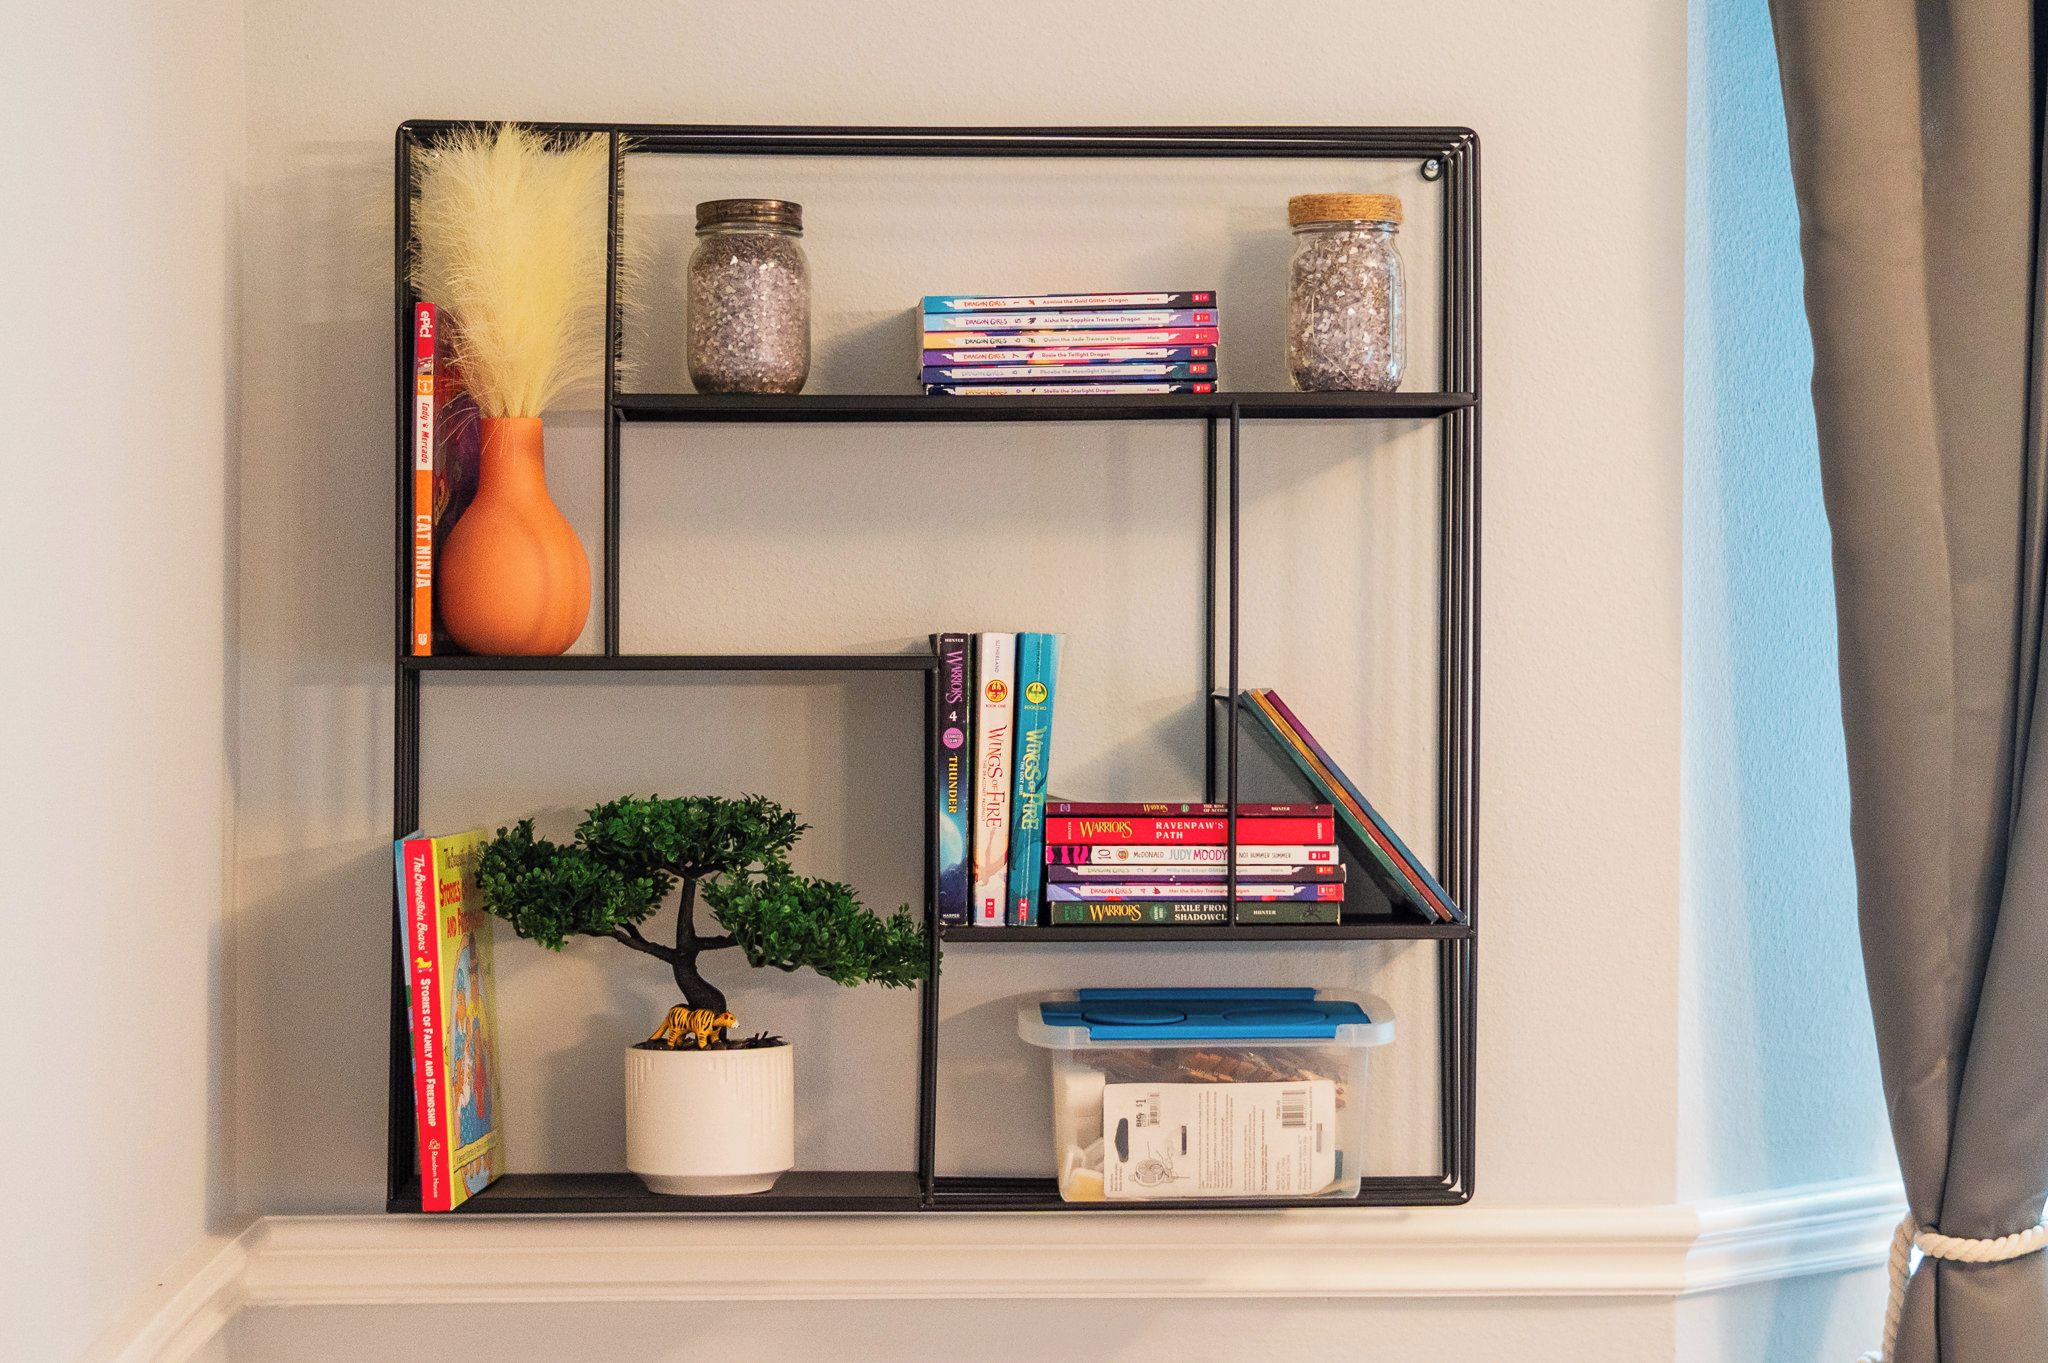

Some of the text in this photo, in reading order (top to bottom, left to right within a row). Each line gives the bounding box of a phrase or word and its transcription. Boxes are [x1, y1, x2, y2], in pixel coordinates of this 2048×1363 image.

[419, 402, 431, 465] Cody Mercado
[416, 514, 432, 589] CAT NINJA
[945, 650, 963, 704] WARRIORS
[948, 711, 958, 722] 4
[1023, 725, 1048, 780] WINGS
[948, 755, 959, 814] THUNDER
[986, 724, 1008, 828] WINGS OF FIRE
[1021, 792, 1044, 830] FIRE
[1143, 804, 1169, 813] WARRIORS
[1080, 821, 1133, 839] WARRIORS
[1156, 822, 1224, 830] RAVENPAW'S
[413, 854, 425, 874] The
[1169, 849, 1228, 861] JUDY MOODY
[414, 873, 427, 922] Berenstain
[1115, 887, 1133, 895] GIRLS
[1090, 904, 1142, 922] WARRIORS
[1174, 904, 1201, 912] EXILE
[1174, 913, 1239, 921] SHADOWCL
[421, 978, 437, 1127] STORIES OF FAMILY AND FRIENDSHIP
